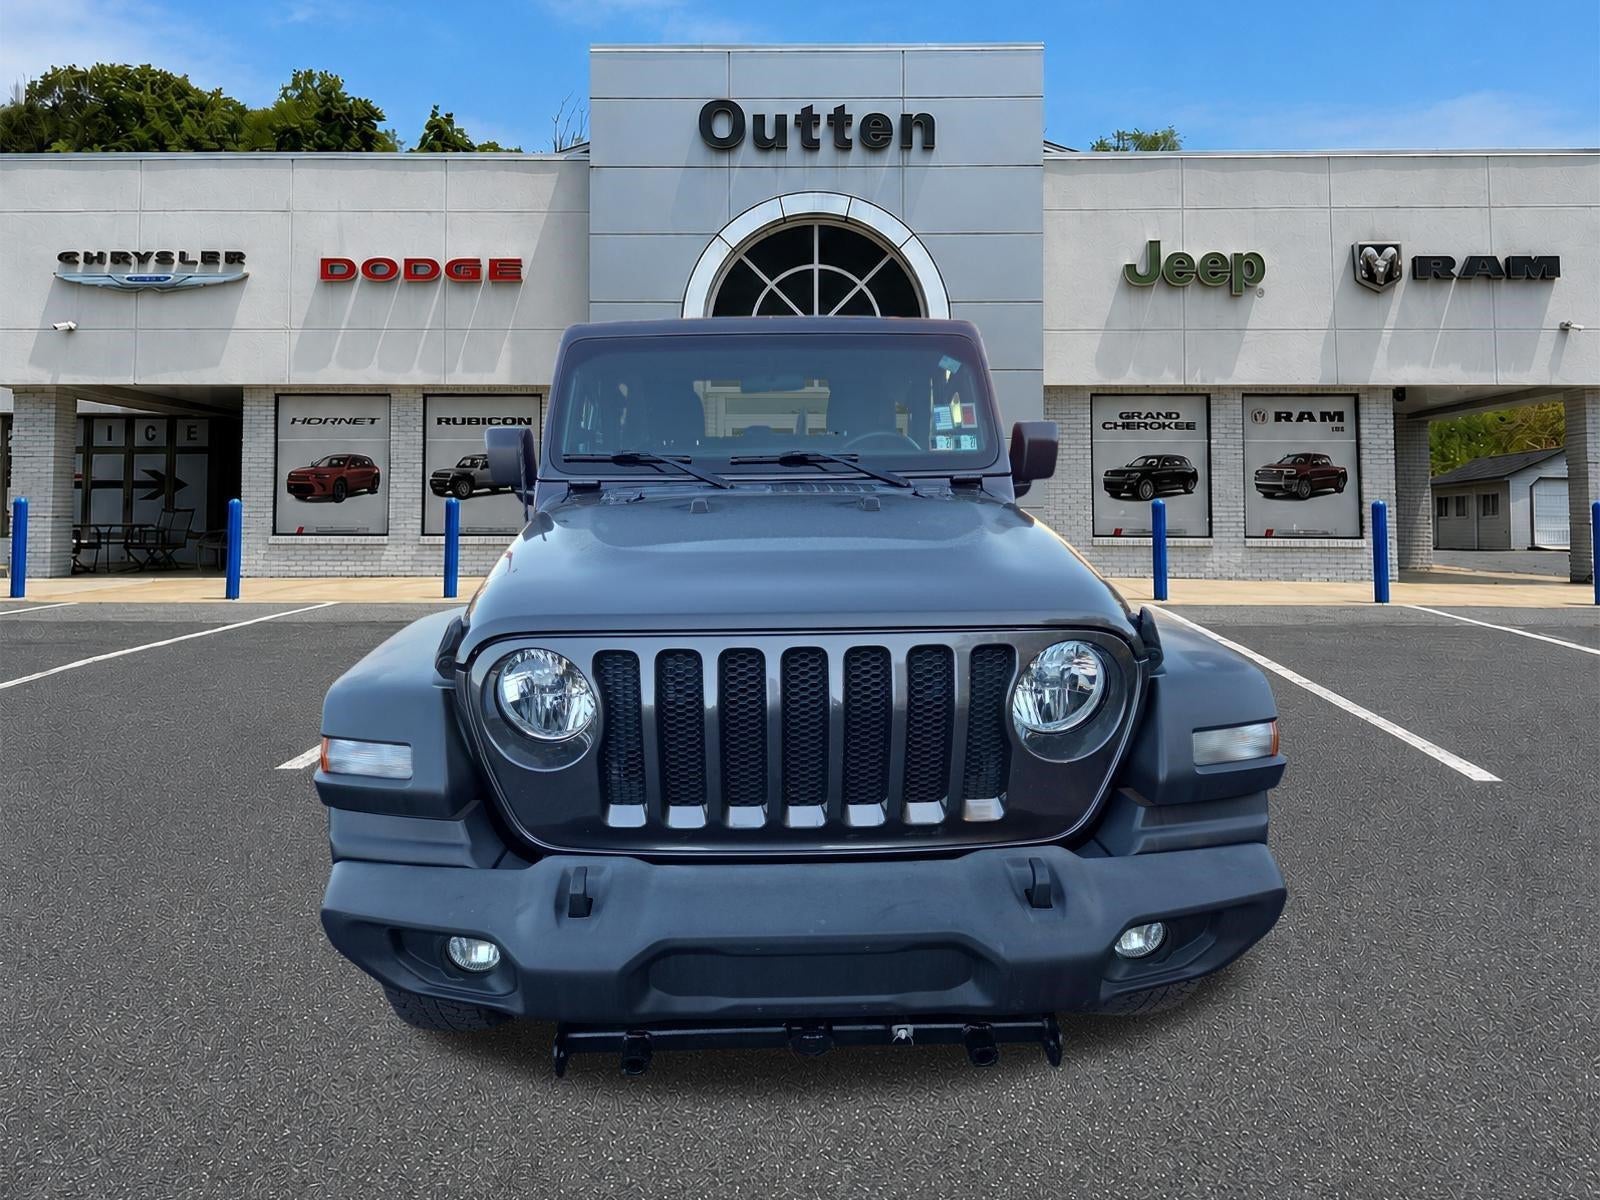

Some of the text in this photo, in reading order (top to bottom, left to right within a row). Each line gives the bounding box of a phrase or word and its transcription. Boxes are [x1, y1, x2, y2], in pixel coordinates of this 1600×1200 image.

[699, 99, 936, 150] Outten
[57, 250, 247, 266] CHRYSLER
[319, 257, 523, 282] DODGE
[1123, 239, 1266, 296] Jeep
[1411, 255, 1561, 281] RAM
[290, 416, 381, 426] HORNET
[436, 416, 533, 426] RUBICON
[1118, 411, 1181, 421] GRAND
[1273, 411, 1345, 423] RAM
[1101, 421, 1197, 431] CHEROKEE
